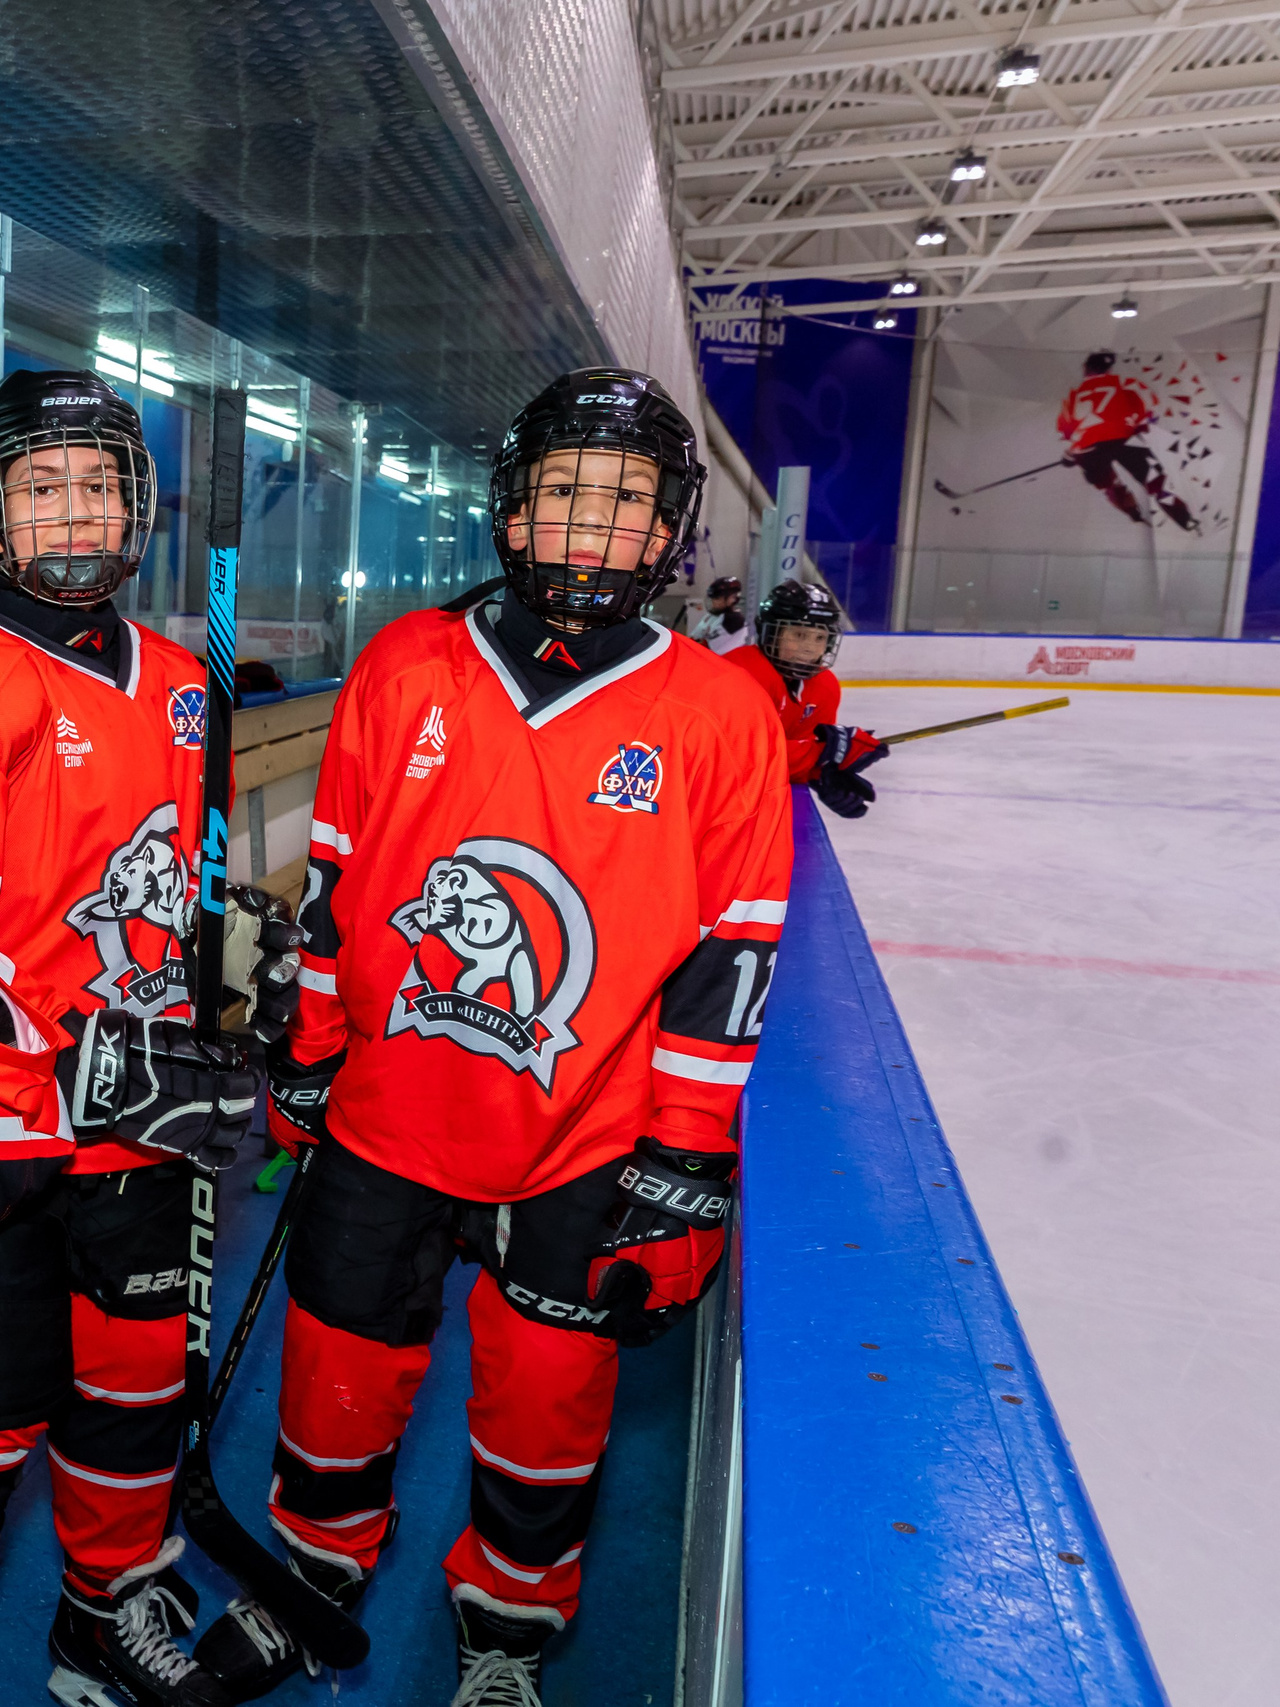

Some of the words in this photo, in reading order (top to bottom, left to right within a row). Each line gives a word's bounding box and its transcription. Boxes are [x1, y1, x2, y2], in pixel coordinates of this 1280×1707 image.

[41, 397, 102, 408] BAUER
[576, 394, 638, 407] CCM
[781, 513, 801, 582] СПО
[603, 773, 655, 798] ФХМ
[138, 976, 166, 999] СШ
[424, 1000, 454, 1015] СШ
[457, 1004, 524, 1047] «ЦЕНТР»
[187, 1177, 215, 1358] AUER
[505, 1280, 611, 1325] CCM
